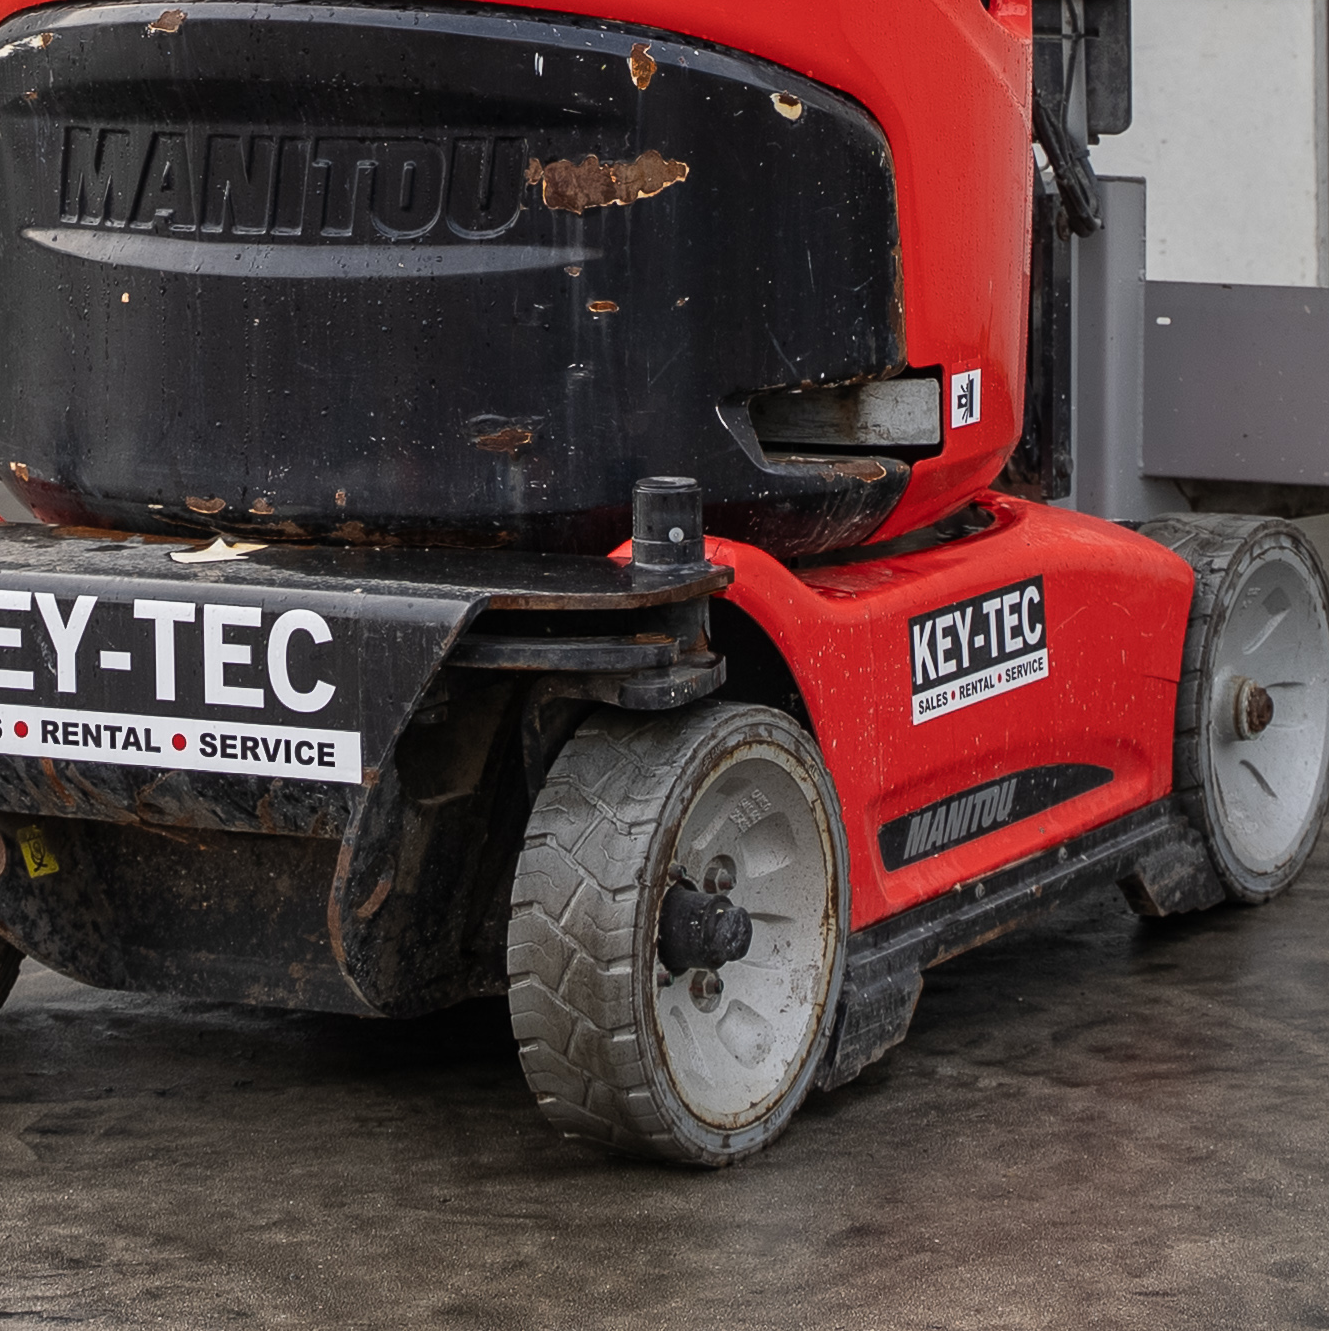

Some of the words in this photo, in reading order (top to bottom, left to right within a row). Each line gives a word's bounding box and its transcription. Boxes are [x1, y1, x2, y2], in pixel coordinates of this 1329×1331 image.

[60, 126, 530, 241] MANITOU
[912, 585, 1044, 686] KEY-TEC
[917, 690, 949, 716] SALES
[958, 674, 996, 701] RENTAL
[1005, 656, 1045, 683] SERVICE
[40, 719, 162, 753] RENTAL
[198, 732, 337, 768] SERVICE
[902, 777, 1019, 861] MANITOU
